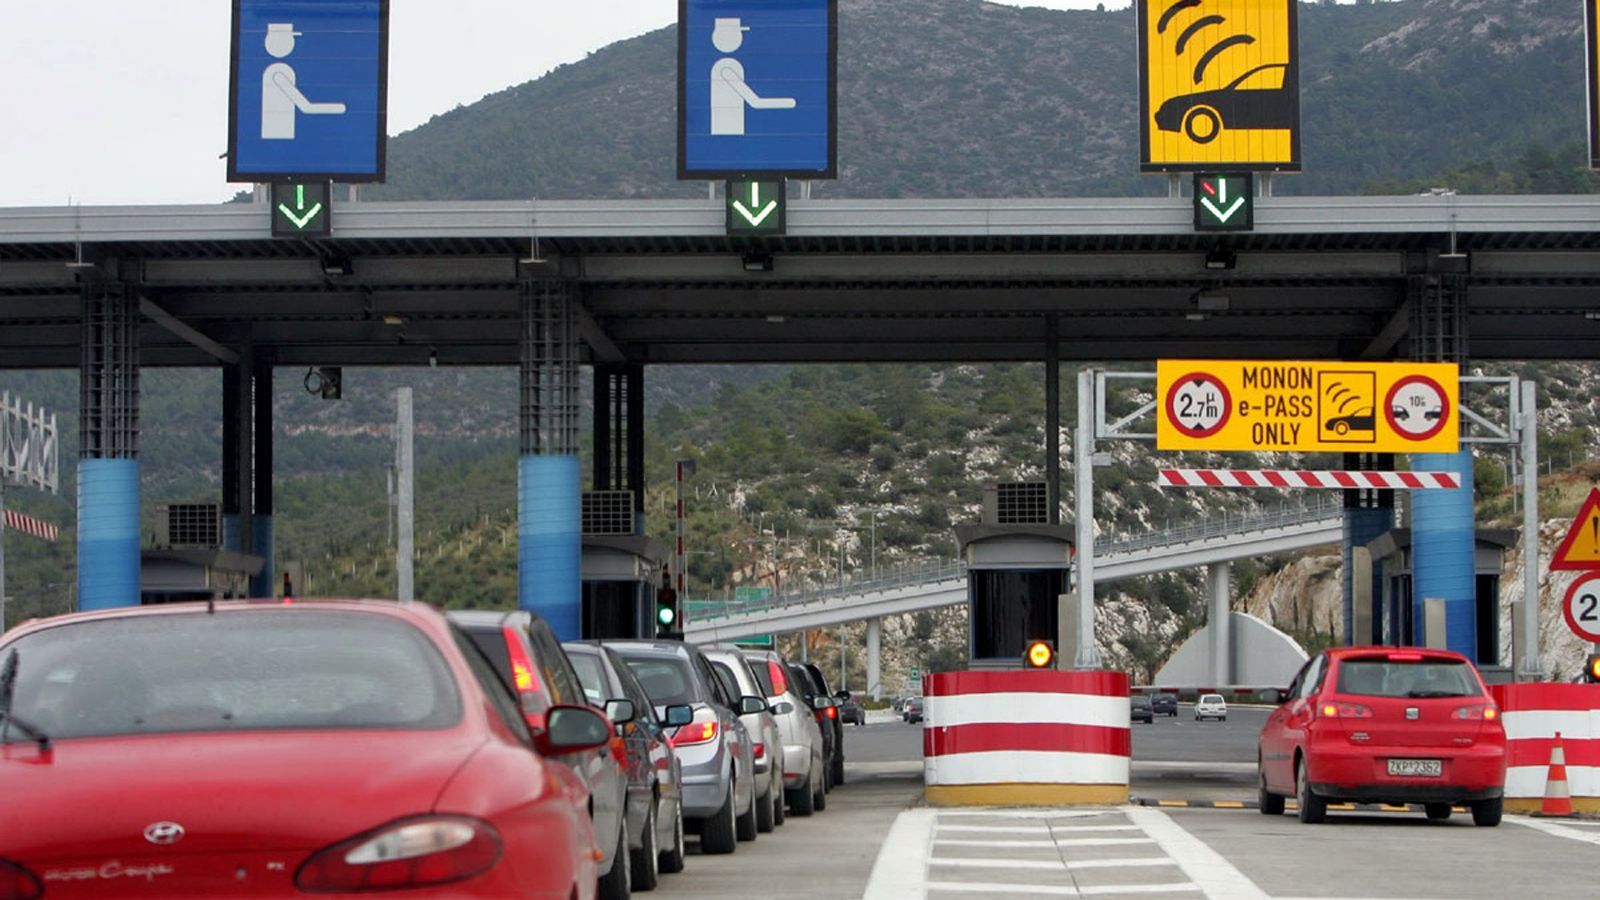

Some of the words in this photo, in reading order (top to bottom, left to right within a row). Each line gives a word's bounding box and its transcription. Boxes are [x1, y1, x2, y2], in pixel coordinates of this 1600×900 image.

[1243, 367, 1312, 389] MONON
[1239, 394, 1312, 417] e-PASS
[1252, 422, 1301, 445] ONLY
